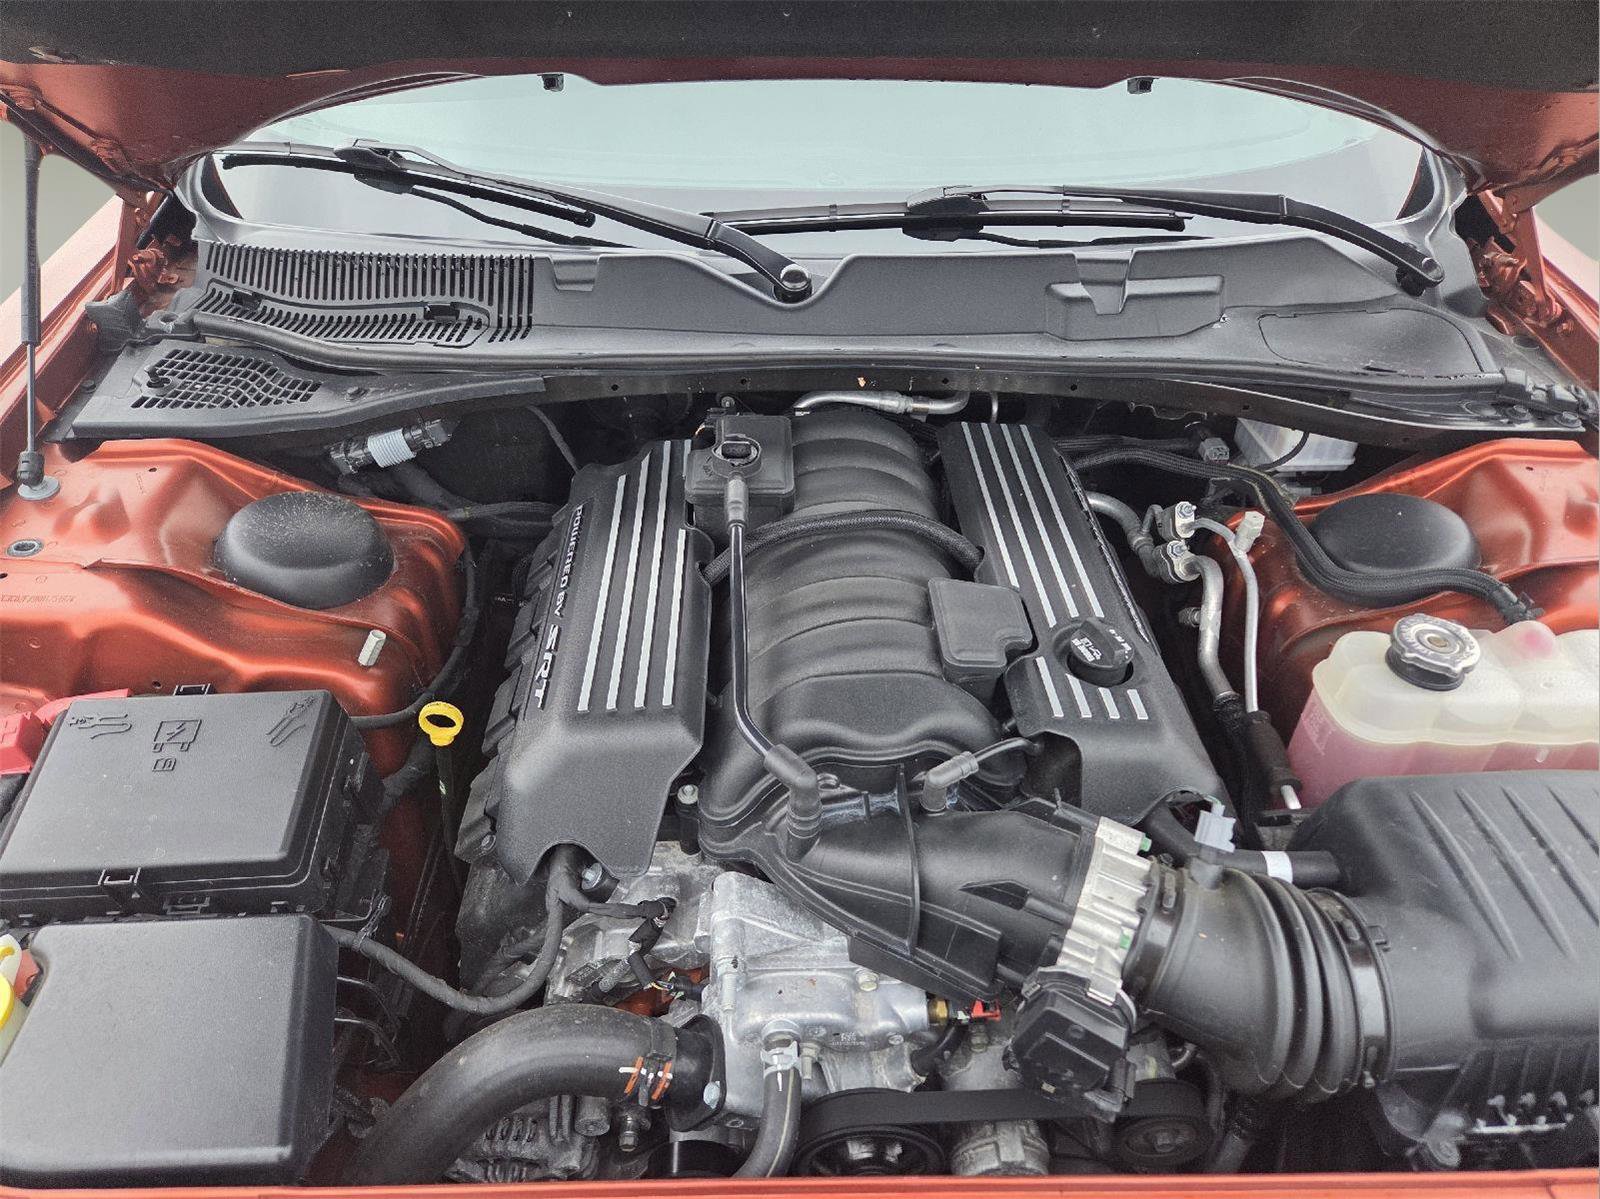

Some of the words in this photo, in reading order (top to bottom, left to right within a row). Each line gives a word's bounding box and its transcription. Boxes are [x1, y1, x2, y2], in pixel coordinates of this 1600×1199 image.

[558, 505, 583, 588] POWERED
[554, 593, 568, 617] BY
[534, 624, 559, 708] SRT
